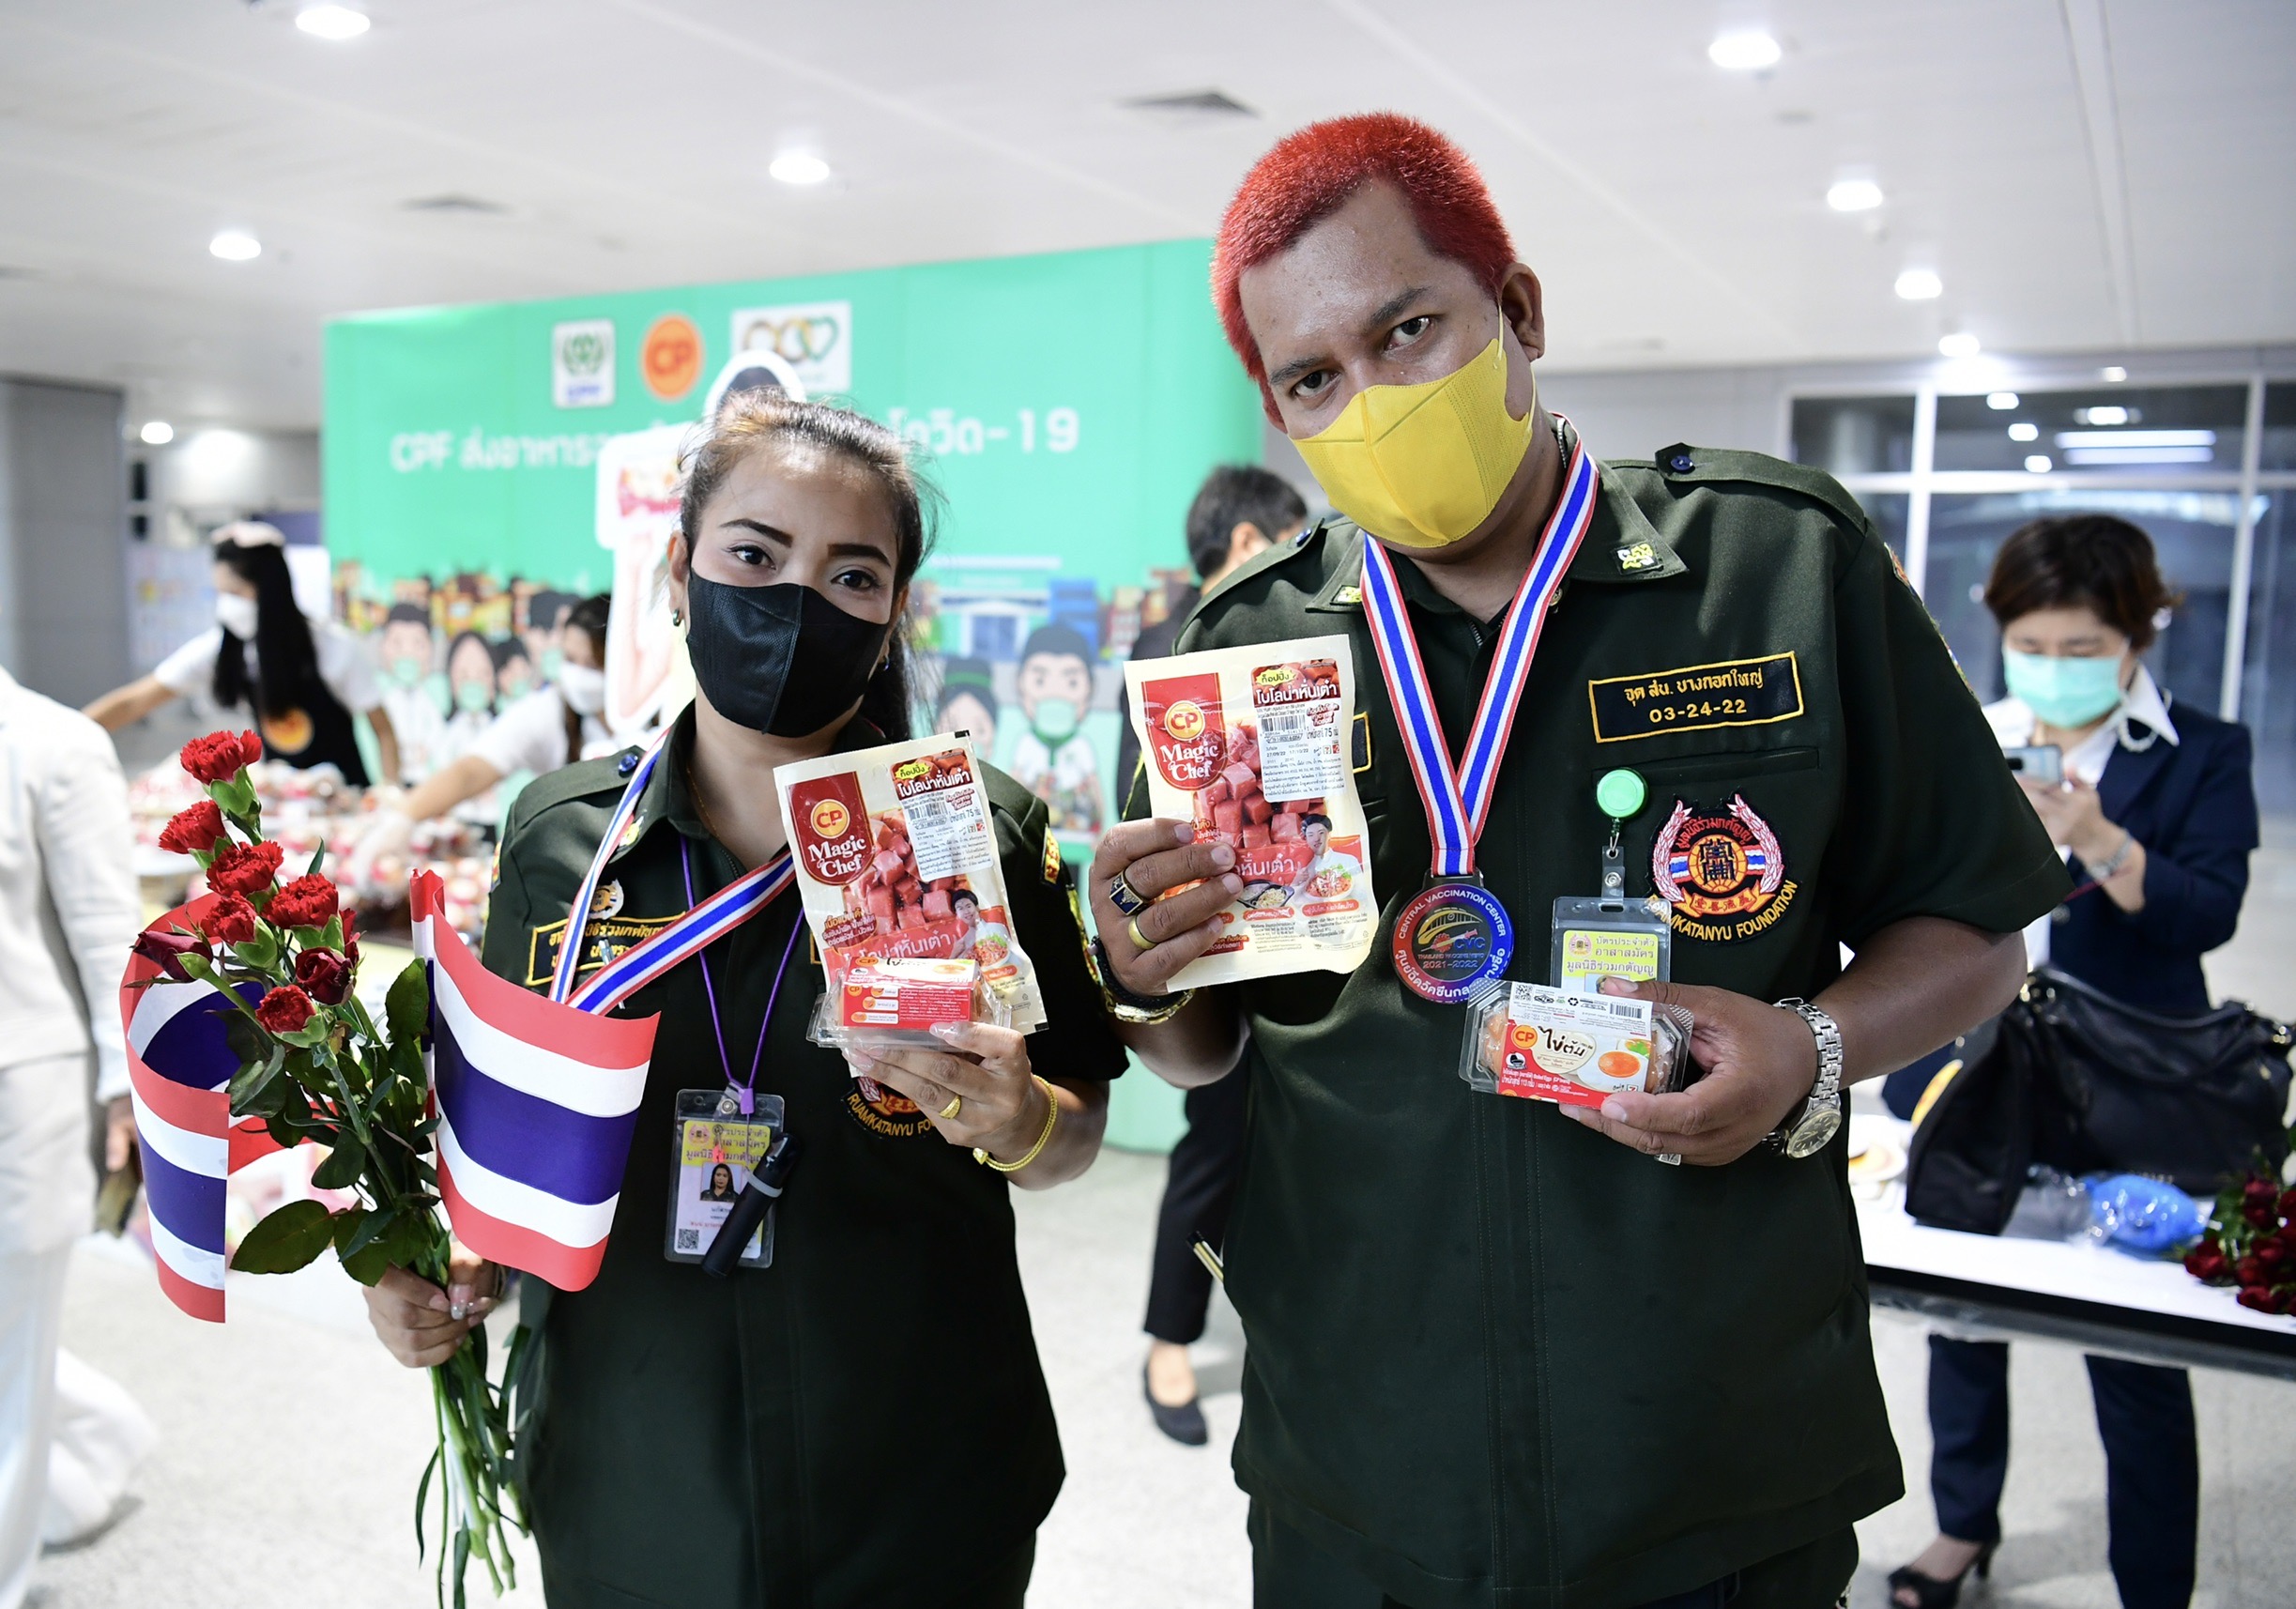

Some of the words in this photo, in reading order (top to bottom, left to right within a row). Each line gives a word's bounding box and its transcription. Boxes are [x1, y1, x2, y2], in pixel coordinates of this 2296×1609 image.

[654, 340, 696, 374] CP
[390, 431, 453, 472] CPF
[1676, 667, 1763, 694] บางกอกใหญ่
[1171, 711, 1199, 731] CP
[1649, 699, 1747, 723] 03-24-22
[1159, 740, 1219, 764] Magic
[1168, 759, 1212, 783] Chef
[816, 809, 843, 829] CP
[808, 835, 866, 864] Magic
[817, 854, 862, 879] Chef
[1399, 902, 1426, 940] CENTRAL
[1425, 889, 1487, 906] VACCINATION
[1485, 903, 1507, 937] CENTER
[1737, 880, 1799, 939] FOUNDATION
[1596, 947, 1654, 958] อาสาสมัคร
[1514, 1031, 1535, 1044] CP
[1538, 1025, 1586, 1057] ไข่ต้ม
[847, 1093, 914, 1137] RUAMKATANYU
